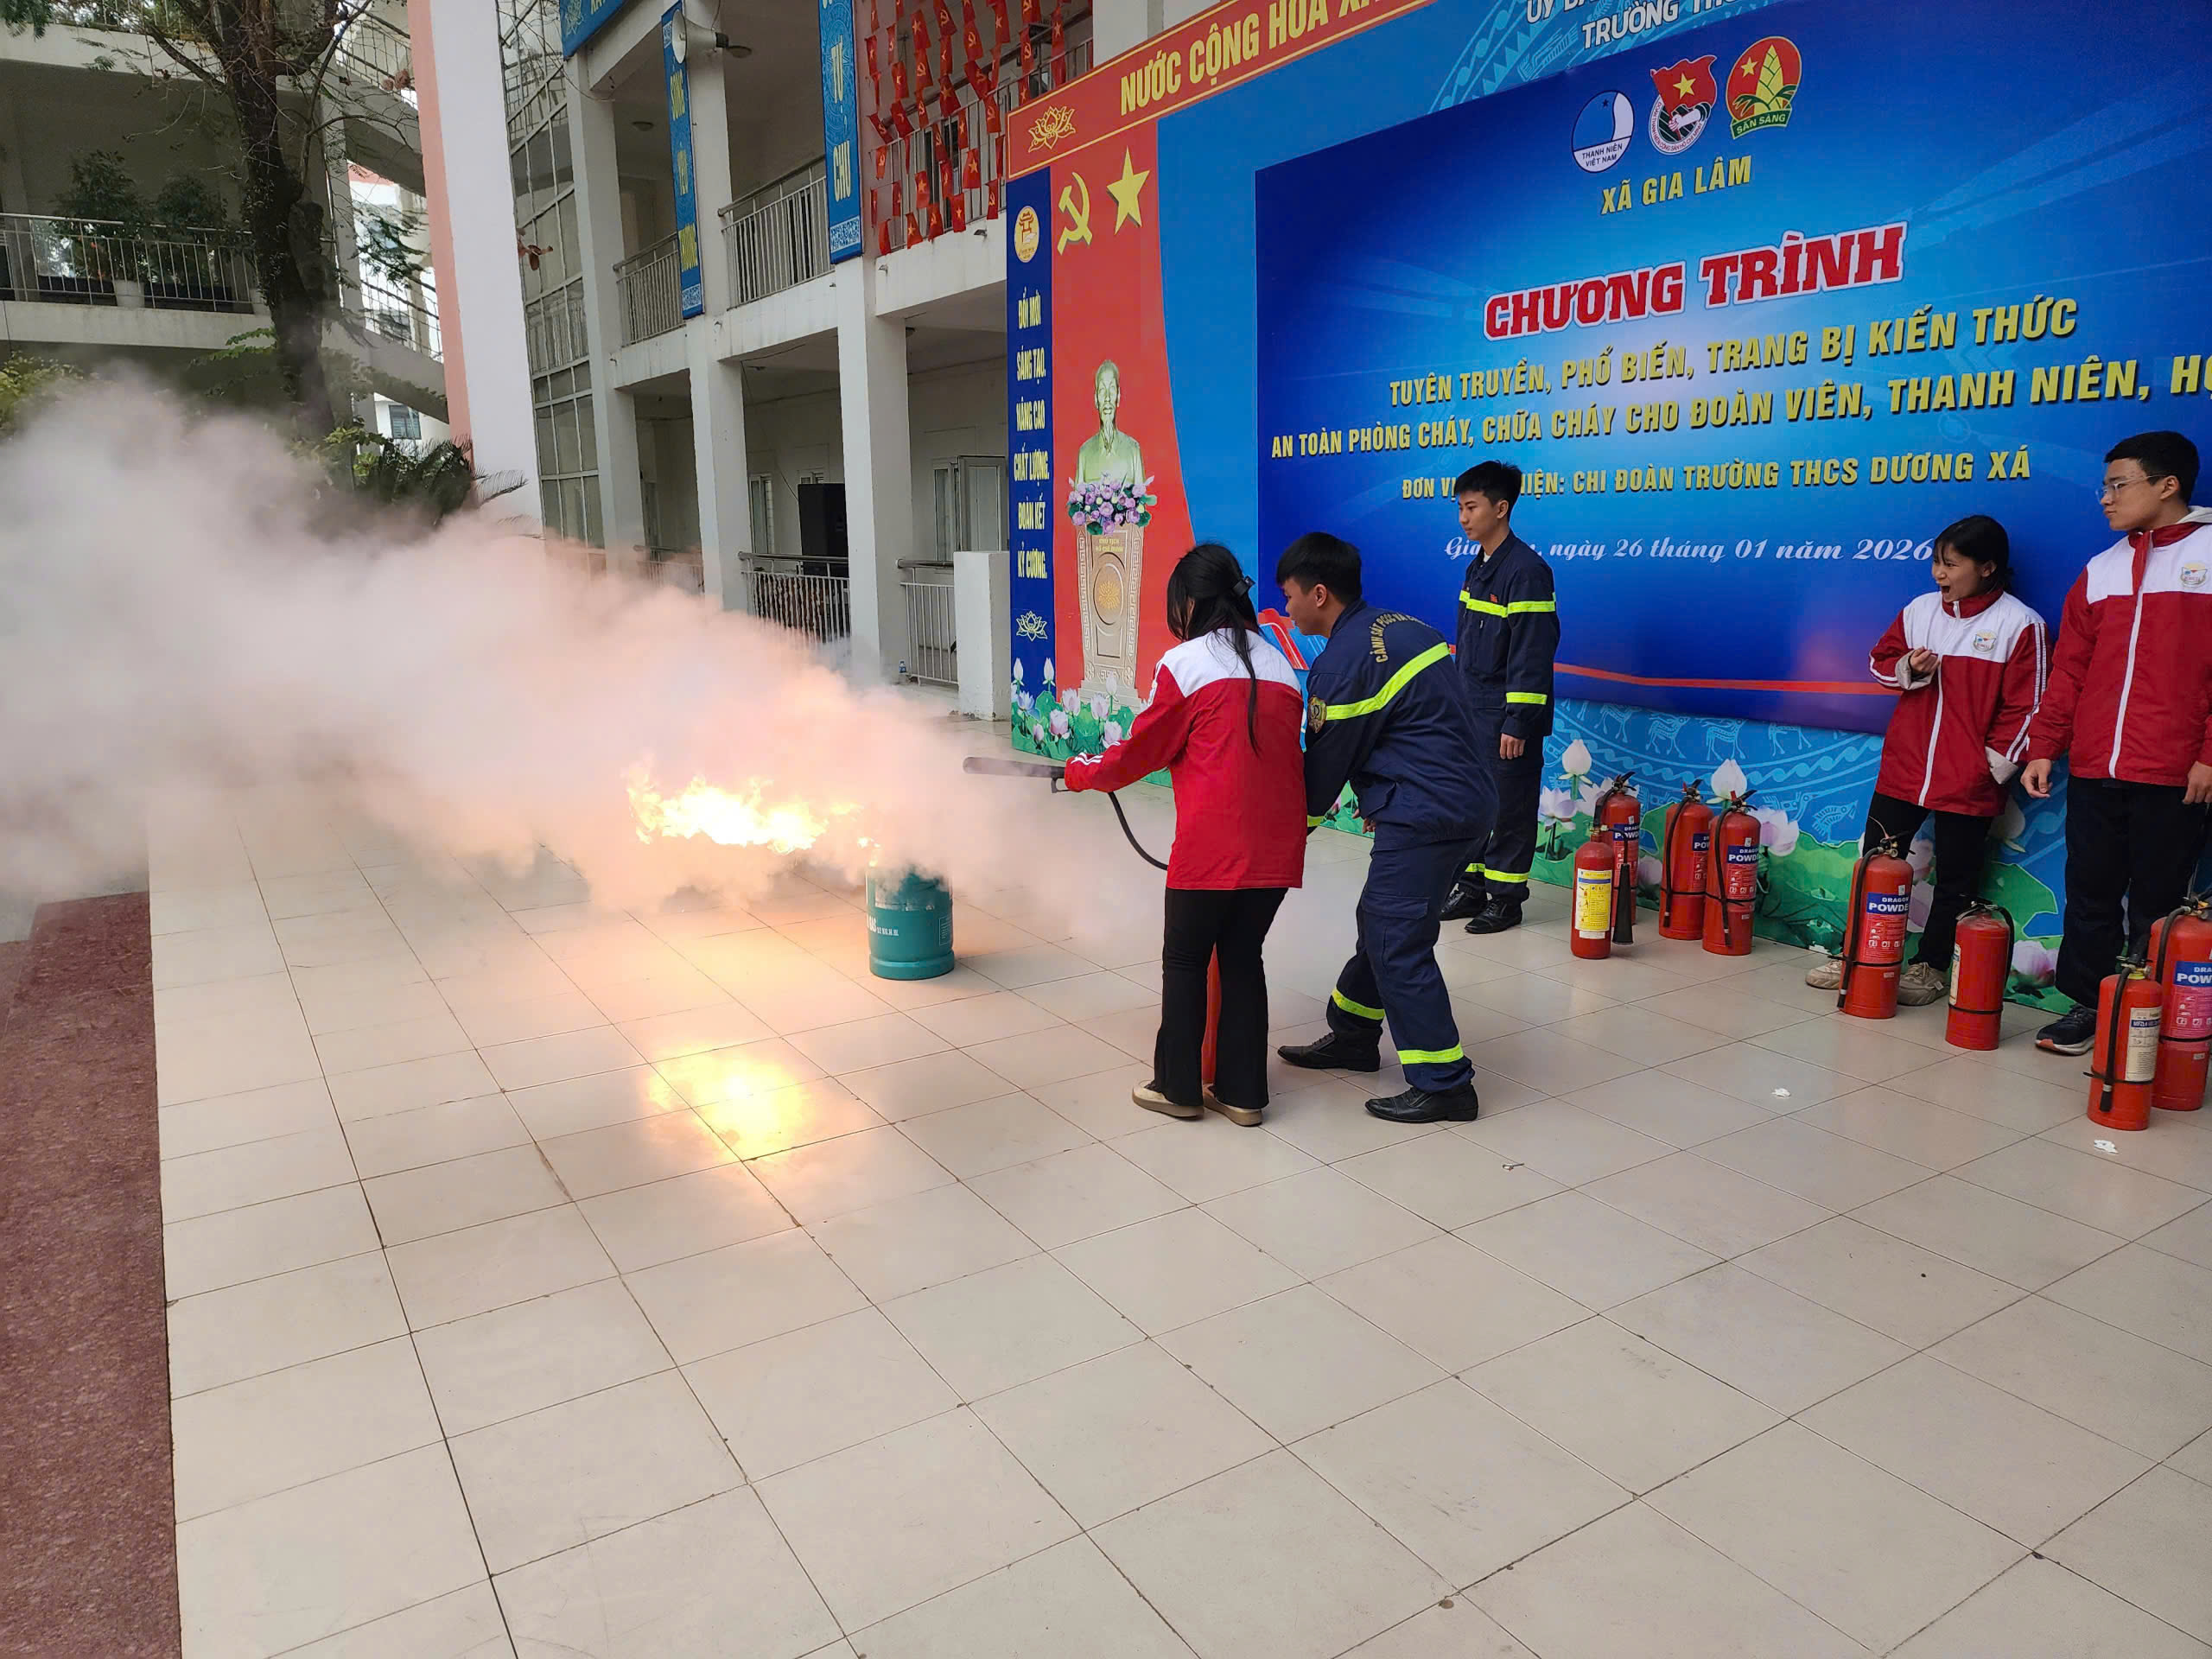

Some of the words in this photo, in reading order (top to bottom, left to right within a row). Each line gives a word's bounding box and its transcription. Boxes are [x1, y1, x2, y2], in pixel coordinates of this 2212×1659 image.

[1582, 0, 1679, 49] TRƯỜNG
[1121, 50, 1181, 116] NƯỚC
[1189, 13, 1260, 86] CỘNG
[1582, 148, 1605, 159] THANH
[1606, 143, 1623, 154] NIÊN
[1602, 154, 1617, 163] NAM
[1601, 178, 1632, 214] XÃ
[1643, 172, 1683, 206] GIA
[1694, 156, 1751, 194] LÂM
[1484, 263, 1685, 340] CHƯƠNG
[1700, 222, 1906, 308] TRÌNH
[1016, 346, 1033, 381] SÁNG
[1389, 372, 1452, 406] TUYÊN
[1459, 357, 1552, 399] TRUYỀN,
[1621, 340, 1694, 383] BIẾN,
[1707, 330, 1808, 373] TRANG
[1821, 324, 1855, 366] BỊ
[1867, 303, 1957, 355] KIẾN
[1973, 294, 2077, 345] THỨC
[1033, 399, 1046, 429] CAO
[1272, 435, 1294, 458] AN
[1300, 427, 1342, 456] TOÀN
[1349, 421, 1411, 453] PHÒNG
[1418, 415, 1474, 448] CHÁY,
[1483, 408, 1542, 443] CHỮA
[1551, 402, 1617, 438] CHÁY
[1625, 400, 1679, 434] CHO
[1689, 388, 1773, 429] ĐOÀN
[1785, 378, 1873, 422] VIÊN,
[1888, 370, 2015, 414] THANH
[2030, 355, 2150, 404] NIÊN,
[1402, 477, 1435, 499] ĐƠN
[1573, 469, 1607, 493] CHI
[1614, 463, 1675, 492] ĐOÀN
[1683, 457, 1779, 490] TRƯỜNG
[1790, 457, 1859, 486] THCS
[1870, 451, 1974, 483] DƯƠNG
[1987, 444, 2031, 480] XÁ
[1034, 493, 1046, 530] KẾT
[1550, 538, 1607, 560] ngày
[1613, 538, 1643, 557] 26
[1649, 537, 1726, 563] tháng
[1734, 538, 1768, 559] 01
[1776, 540, 1844, 559] năm
[1853, 538, 1935, 560] 2026
